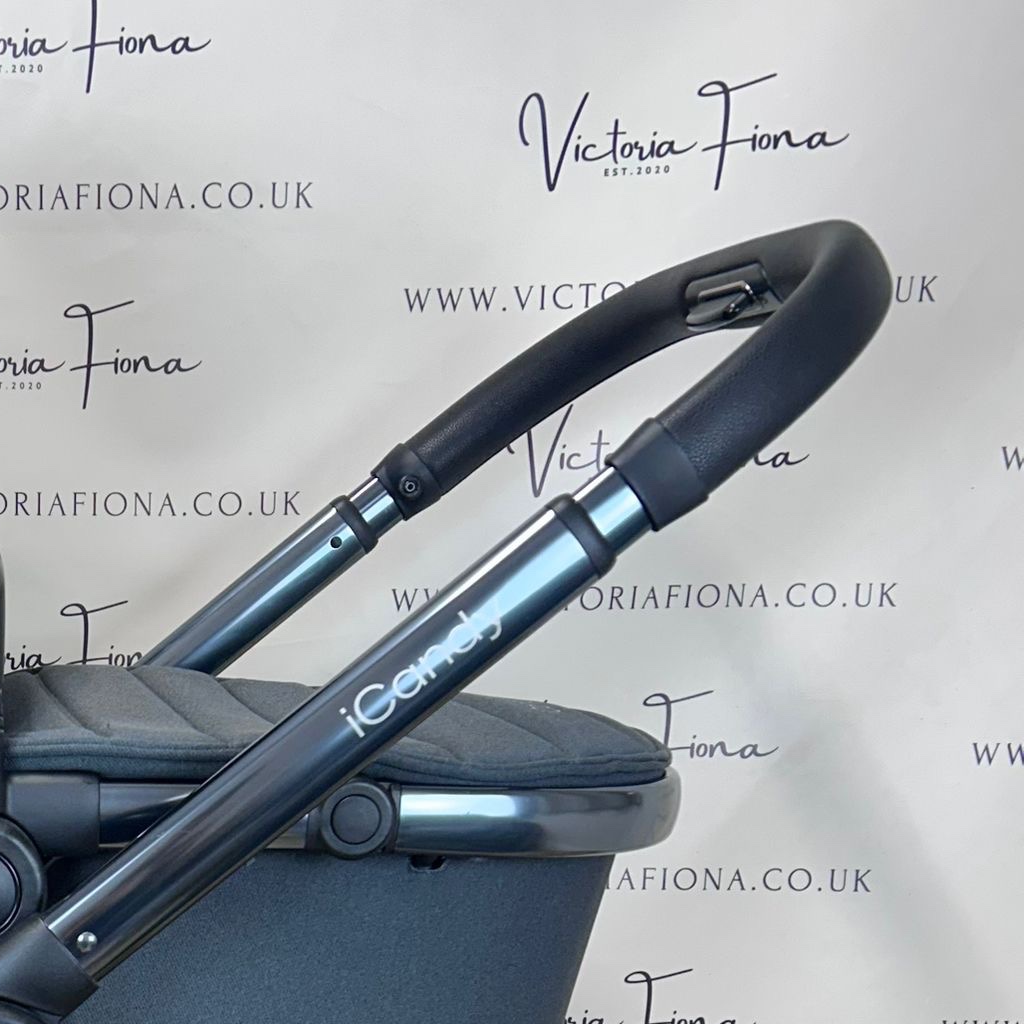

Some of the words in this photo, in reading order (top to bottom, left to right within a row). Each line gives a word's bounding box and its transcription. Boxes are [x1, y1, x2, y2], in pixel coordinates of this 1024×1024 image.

[518, 91, 698, 192] Victoria
[697, 72, 850, 191] Fiona
[603, 165, 672, 177] EST.2020
[63, 299, 203, 410] Fiona
[337, 597, 503, 739] iCandy
[642, 690, 780, 759] Fiona
